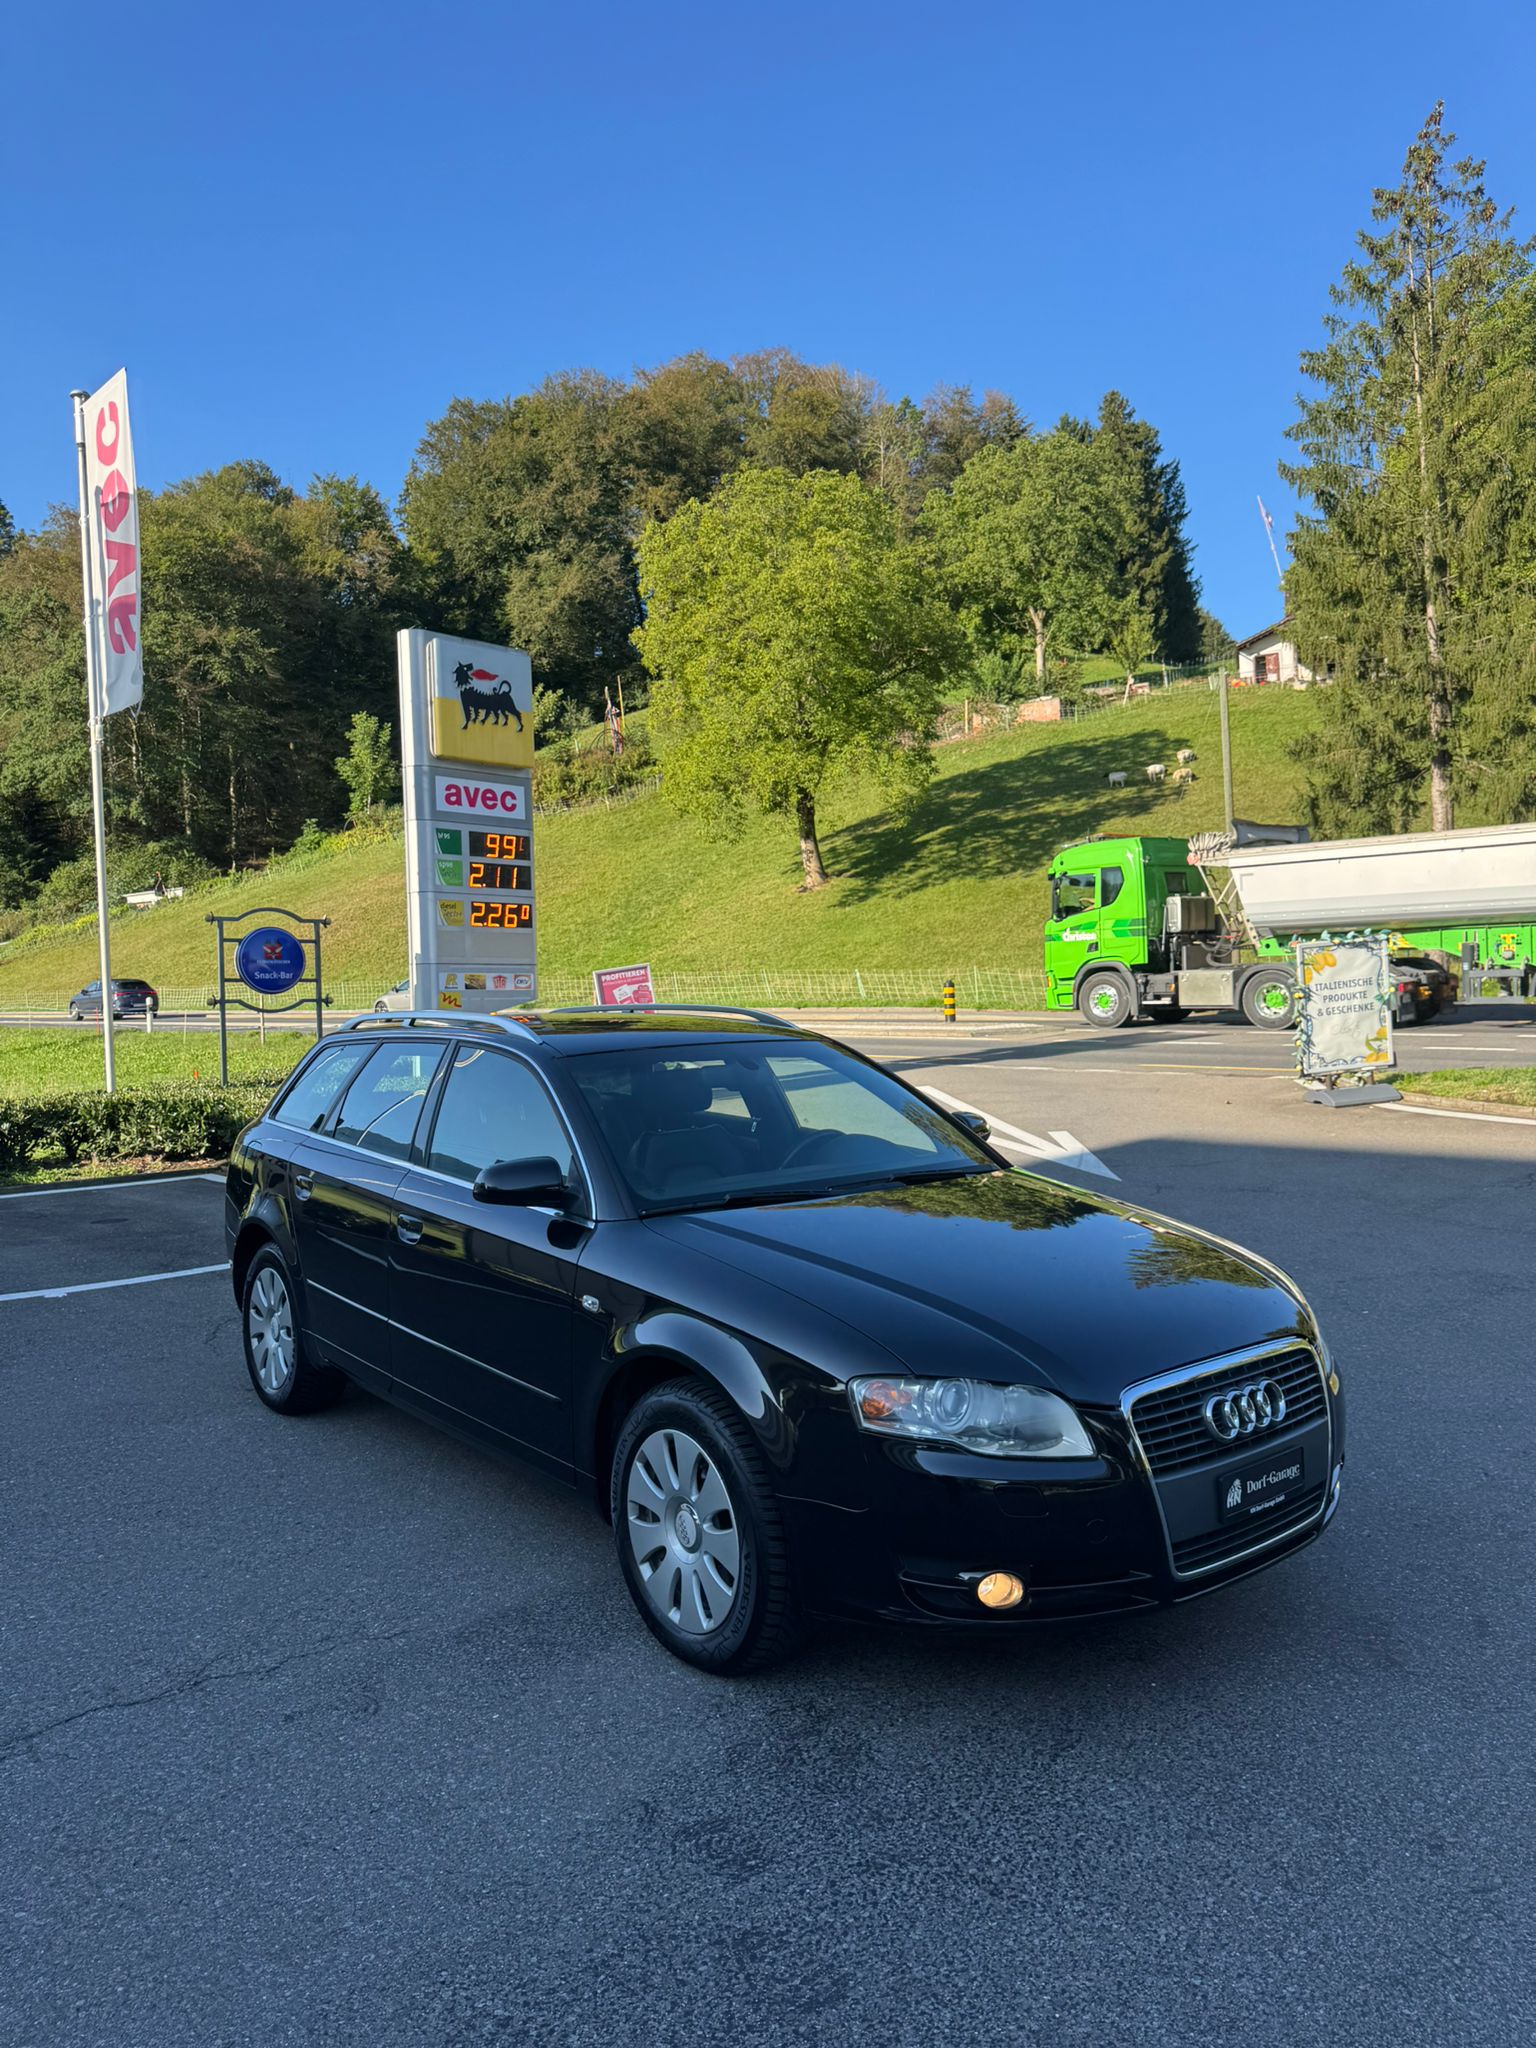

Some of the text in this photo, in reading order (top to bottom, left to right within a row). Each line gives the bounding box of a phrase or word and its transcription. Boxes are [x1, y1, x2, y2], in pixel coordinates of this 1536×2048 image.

[95, 400, 137, 655] avec
[444, 783, 517, 812] avec
[468, 863, 518, 889] 2.11
[254, 971, 294, 979] Snack-Bar
[1314, 976, 1373, 991] ITALIENISCHE
[1322, 990, 1368, 1003] PRODUKTE
[1317, 1002, 1375, 1017] & GESCHENKE
[1246, 1464, 1300, 1493] Dorf-Garage
